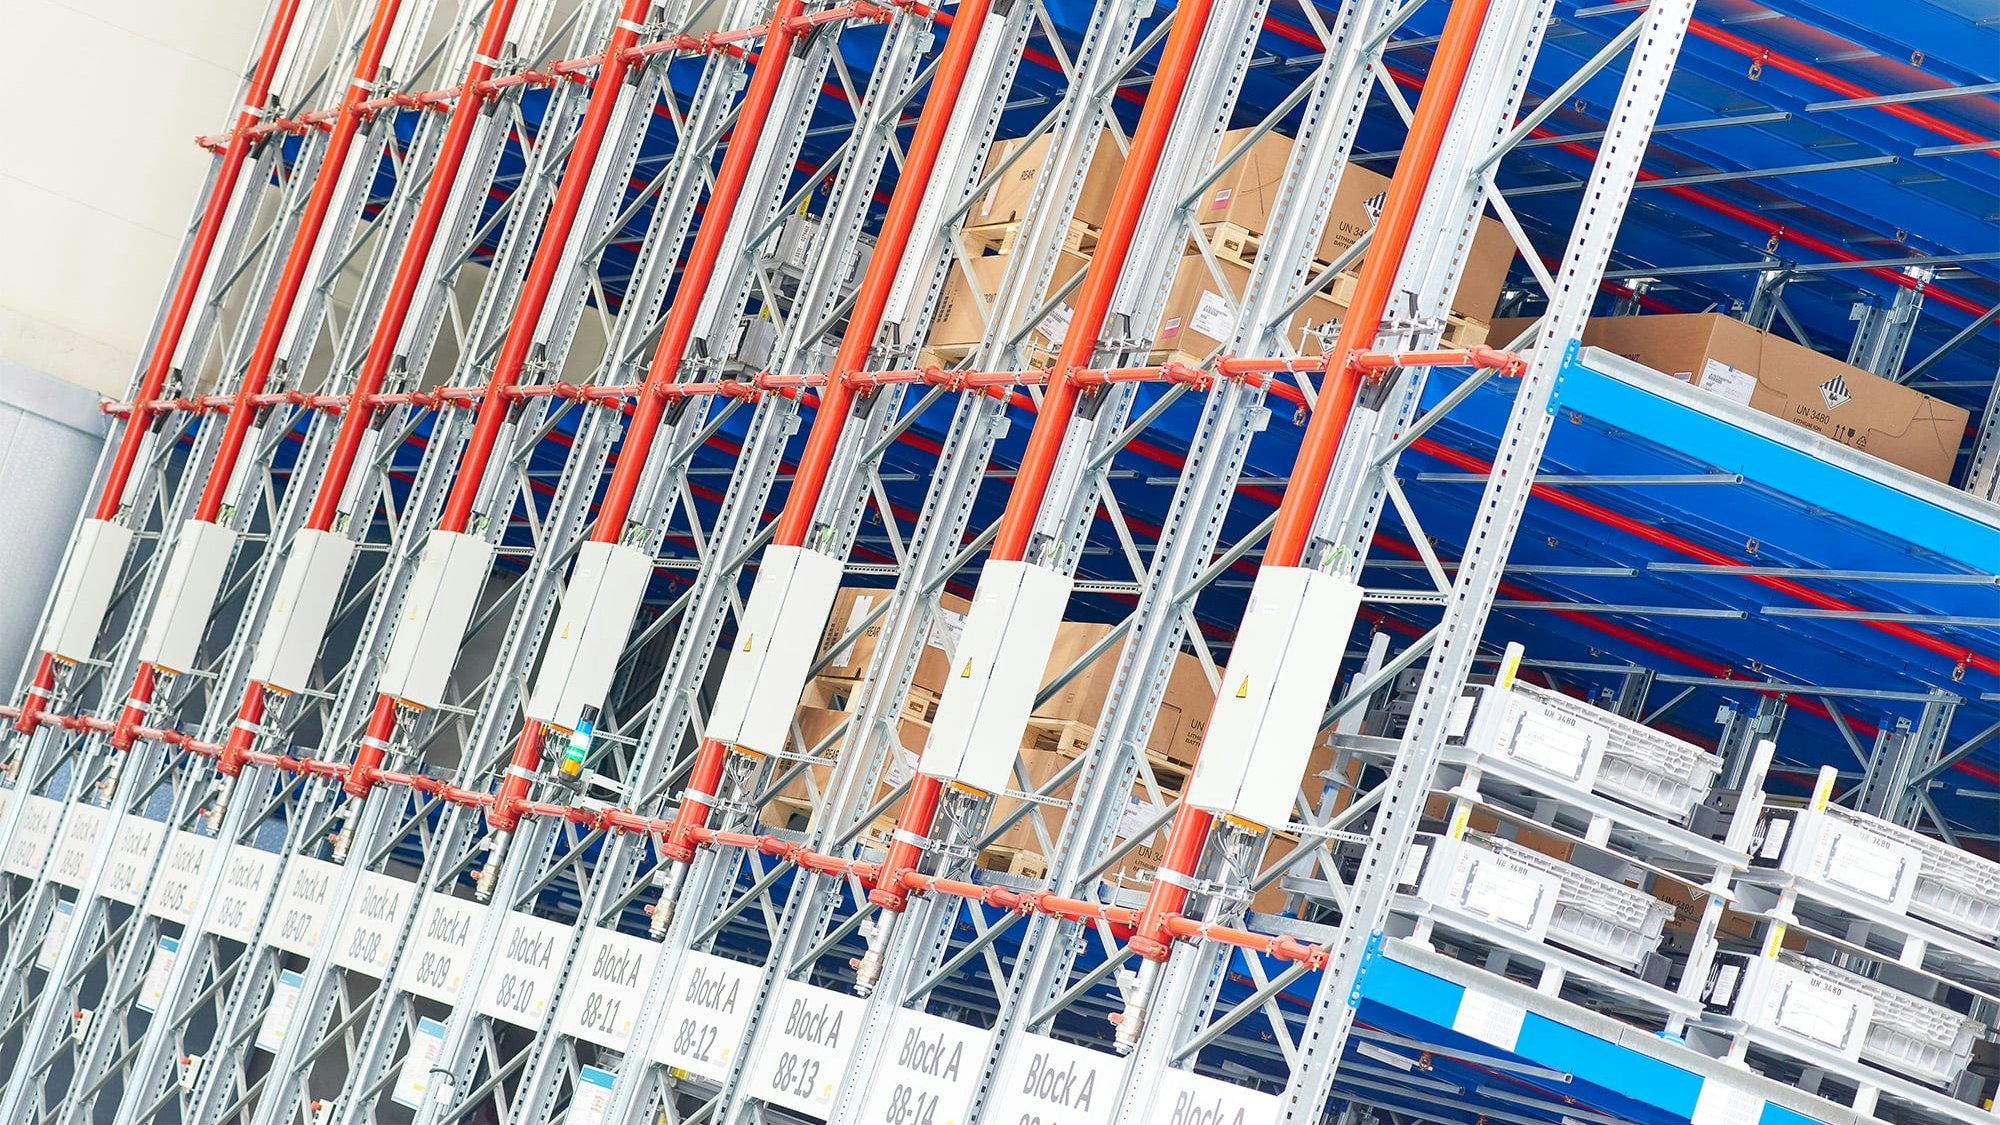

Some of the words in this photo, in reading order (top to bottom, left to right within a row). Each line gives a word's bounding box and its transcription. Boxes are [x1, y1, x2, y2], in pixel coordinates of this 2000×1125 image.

[1339, 220, 1353, 233] UN
[1796, 404, 1811, 417] UN
[1810, 409, 1831, 425] 3480
[865, 625, 881, 638] REAR
[1191, 719, 1206, 731] UN
[191, 848, 204, 876] A
[1138, 846, 1153, 859] UN
[250, 864, 264, 892] A
[293, 868, 319, 902] Block
[315, 876, 329, 905] A
[360, 884, 389, 920] Block
[385, 892, 399, 923] A
[281, 909, 313, 942] 88-07
[348, 927, 381, 964] 88-08
[428, 906, 460, 944] Block
[456, 915, 471, 948] A
[506, 926, 542, 967] Block
[538, 936, 554, 970] A
[592, 943, 630, 985] Block
[625, 953, 643, 989] A
[416, 950, 451, 989] 88-09
[495, 973, 535, 1014] 88-10
[685, 966, 726, 1011] Block
[722, 977, 741, 1015] A
[580, 992, 622, 1034] 88-11
[784, 998, 828, 1045] Block
[824, 1010, 843, 1049] A
[673, 1017, 718, 1062] 88-12
[898, 1026, 946, 1077] Block
[942, 1040, 964, 1082] A
[772, 1051, 821, 1099] 88-13
[1023, 1053, 1077, 1107] Block
[1073, 1069, 1096, 1112] A
[886, 1083, 940, 1125] 88-14
